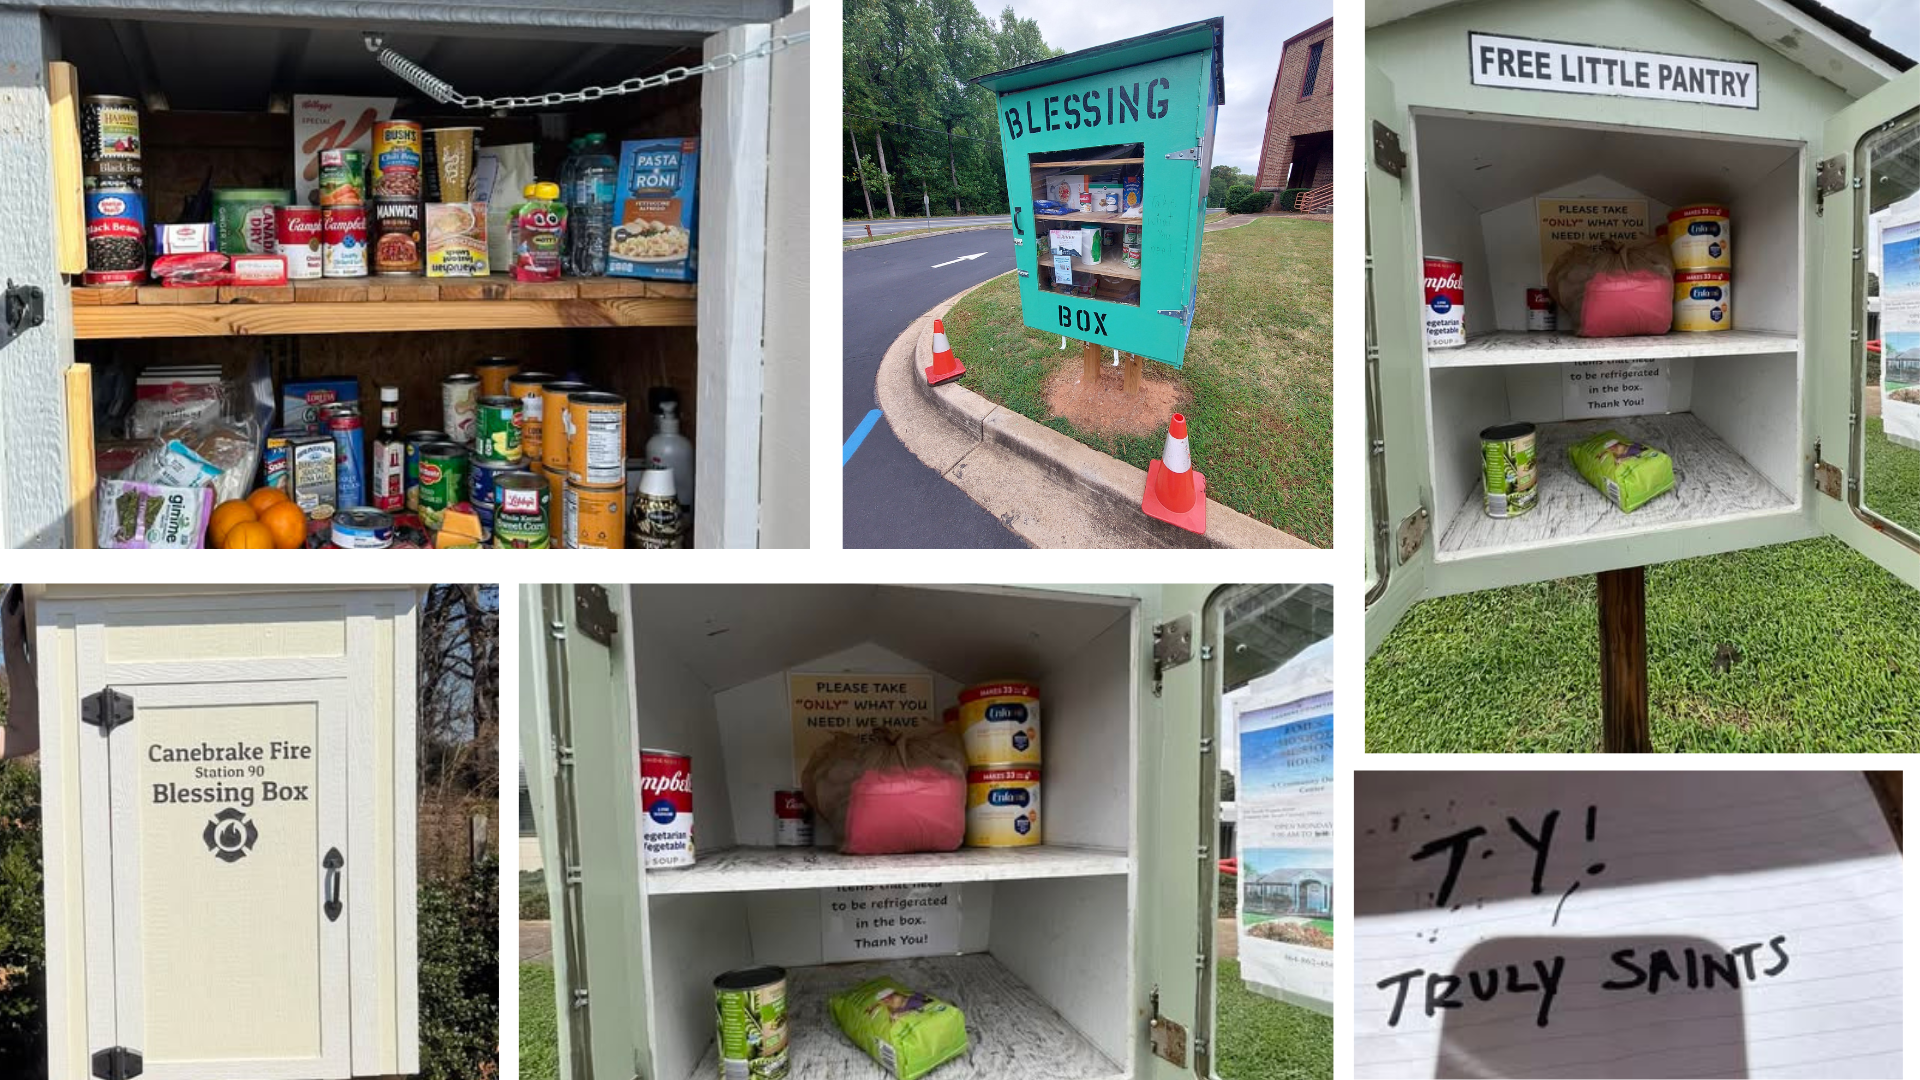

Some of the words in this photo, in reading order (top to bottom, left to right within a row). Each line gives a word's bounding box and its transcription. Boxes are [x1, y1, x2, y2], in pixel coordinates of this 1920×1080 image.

[1480, 45, 1551, 80] FREE
[1560, 54, 1650, 89] LITTLE
[1658, 63, 1751, 98] PANTRY
[1004, 77, 1170, 140] BLESSING
[385, 129, 416, 141] BUSH'S
[100, 162, 125, 172] Black
[638, 154, 678, 167] PASTA
[636, 173, 675, 188] RONI
[376, 204, 418, 220] MANWICH
[1558, 204, 1599, 215] PLEASE
[1602, 205, 1628, 215] TAKE
[112, 222, 140, 234] Beans
[1542, 217, 1584, 228] "ONLY"
[1587, 218, 1620, 228] WHAT
[1621, 218, 1644, 228] YOU
[250, 217, 262, 246] DRY
[1551, 231, 1585, 241] NEED!
[1589, 231, 1608, 241] WE
[1611, 231, 1638, 241] HAVE
[432, 263, 477, 273] Maruchan
[1058, 304, 1109, 336] BOX
[1426, 319, 1459, 328] egetarian
[1569, 371, 1583, 381] to
[1585, 369, 1597, 381] be
[1600, 367, 1659, 382] refrigerated
[1588, 384, 1600, 394] in
[1602, 383, 1619, 393] the
[1622, 382, 1643, 393] box.
[1587, 399, 1620, 409] Thank
[1622, 398, 1645, 408] You!
[508, 494, 535, 507] Libby's
[166, 494, 186, 543] gimme
[499, 521, 522, 531] Sweet
[523, 521, 545, 531] Corn
[816, 682, 868, 693] PLEASE
[872, 682, 907, 693] TAKE
[795, 699, 848, 711] "ONLY"
[854, 700, 896, 711] WHAT
[899, 700, 927, 711] YOU
[807, 717, 851, 728] NEED!
[856, 717, 879, 728] WE
[883, 717, 919, 728] HAVE
[148, 742, 264, 762] Canebrake
[270, 741, 312, 760] Fire
[1286, 754, 1328, 769] HOUSE
[195, 766, 245, 778] Station
[248, 765, 265, 777] 90
[152, 781, 254, 807] Blessing
[261, 781, 309, 801] Box
[644, 831, 687, 843] egetarian
[652, 857, 679, 865] SOUP
[831, 901, 847, 911] to
[851, 899, 867, 911] be
[871, 895, 948, 911] refrigerated
[855, 917, 869, 929] in
[873, 916, 895, 928] the
[899, 915, 926, 927] box.
[854, 937, 897, 949] Thank
[900, 934, 929, 947] You!
[1377, 957, 1565, 1026] TRULY
[1602, 936, 1790, 994] SAINTS
